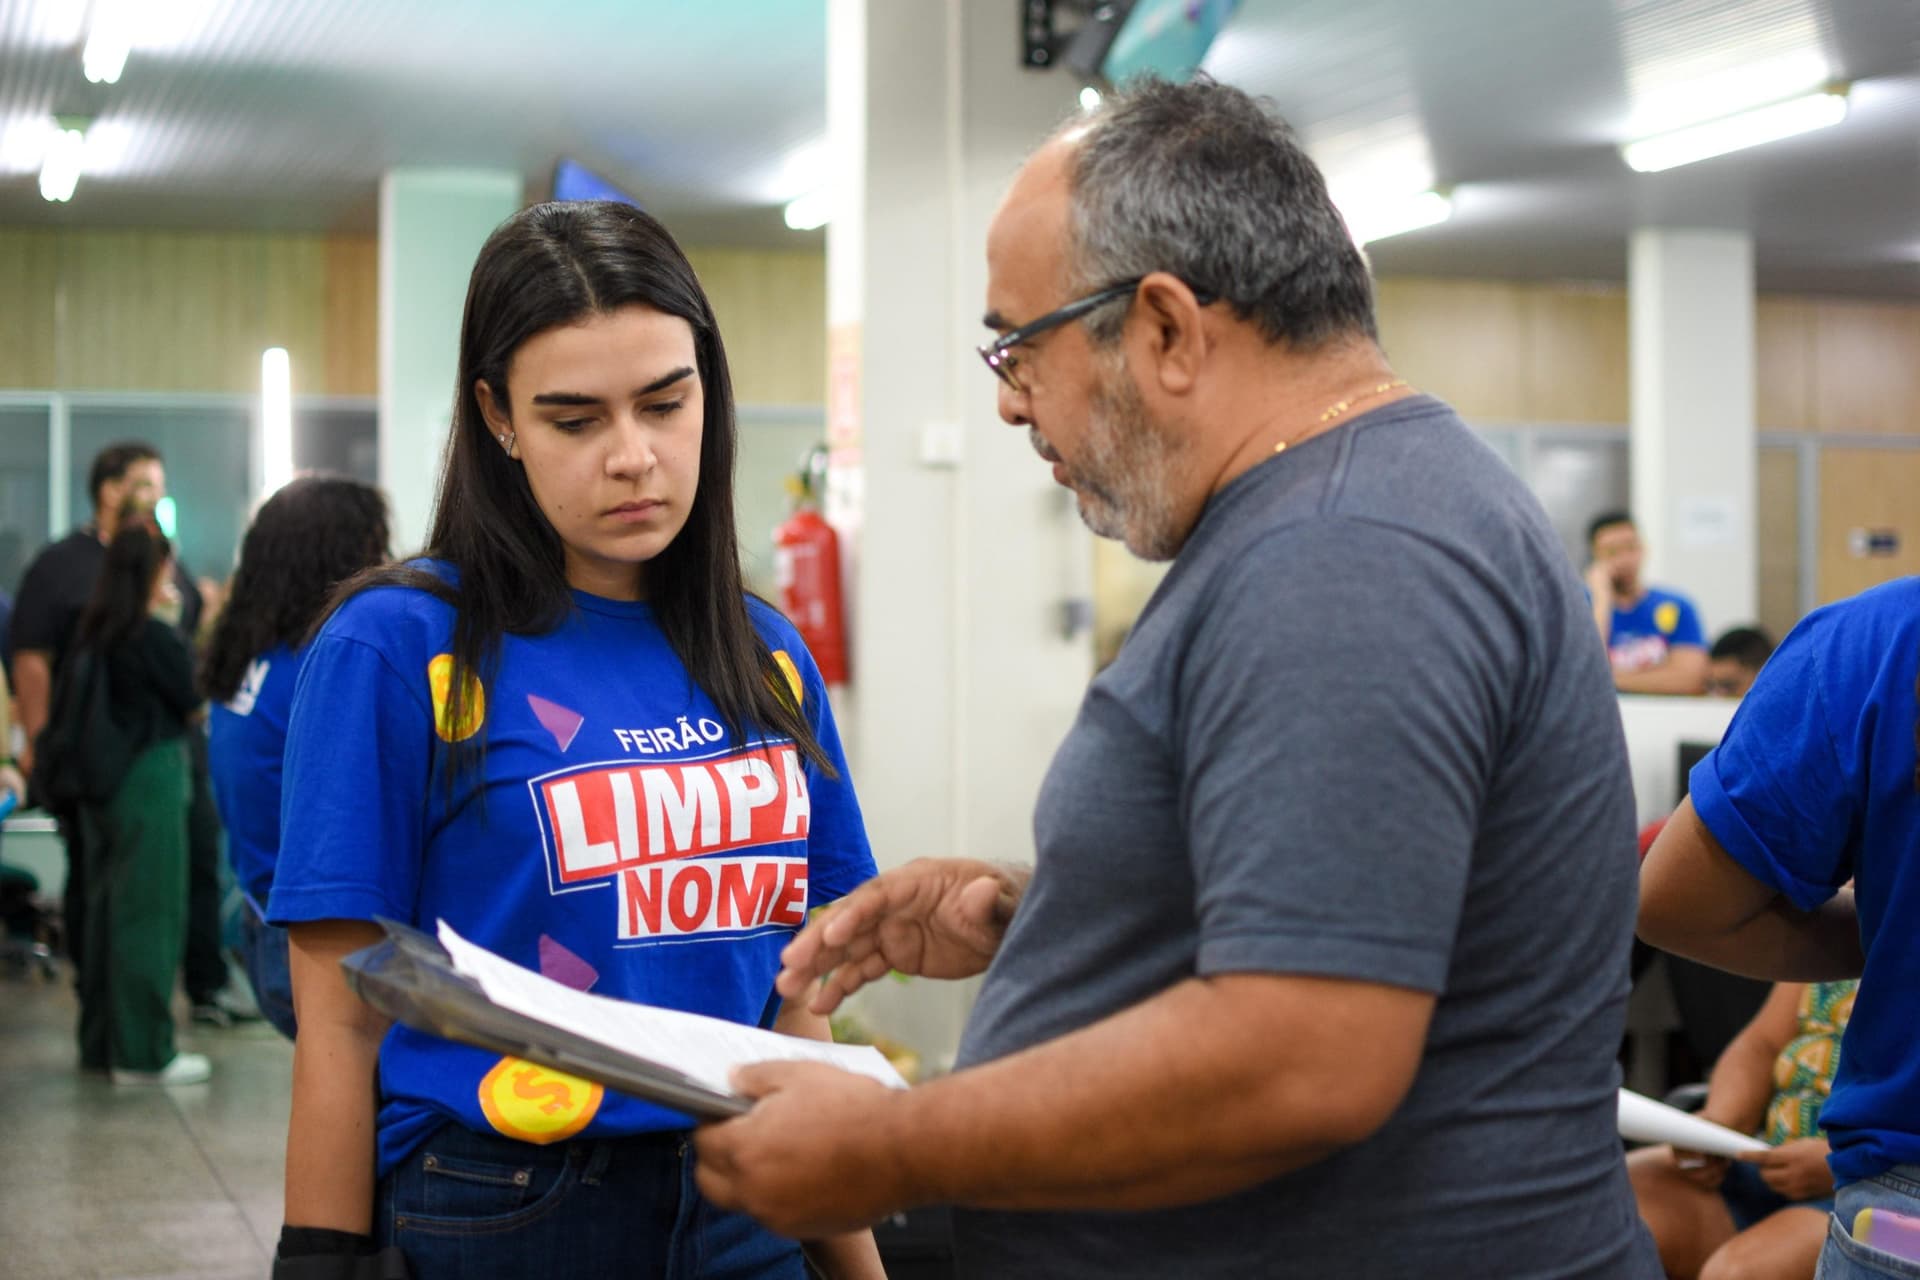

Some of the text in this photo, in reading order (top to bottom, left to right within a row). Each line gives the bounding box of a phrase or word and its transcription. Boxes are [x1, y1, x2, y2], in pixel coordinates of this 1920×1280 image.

[613, 715, 724, 754] FEIRÃO
[549, 750, 811, 872] LIMPA
[623, 864, 809, 937] NOME
